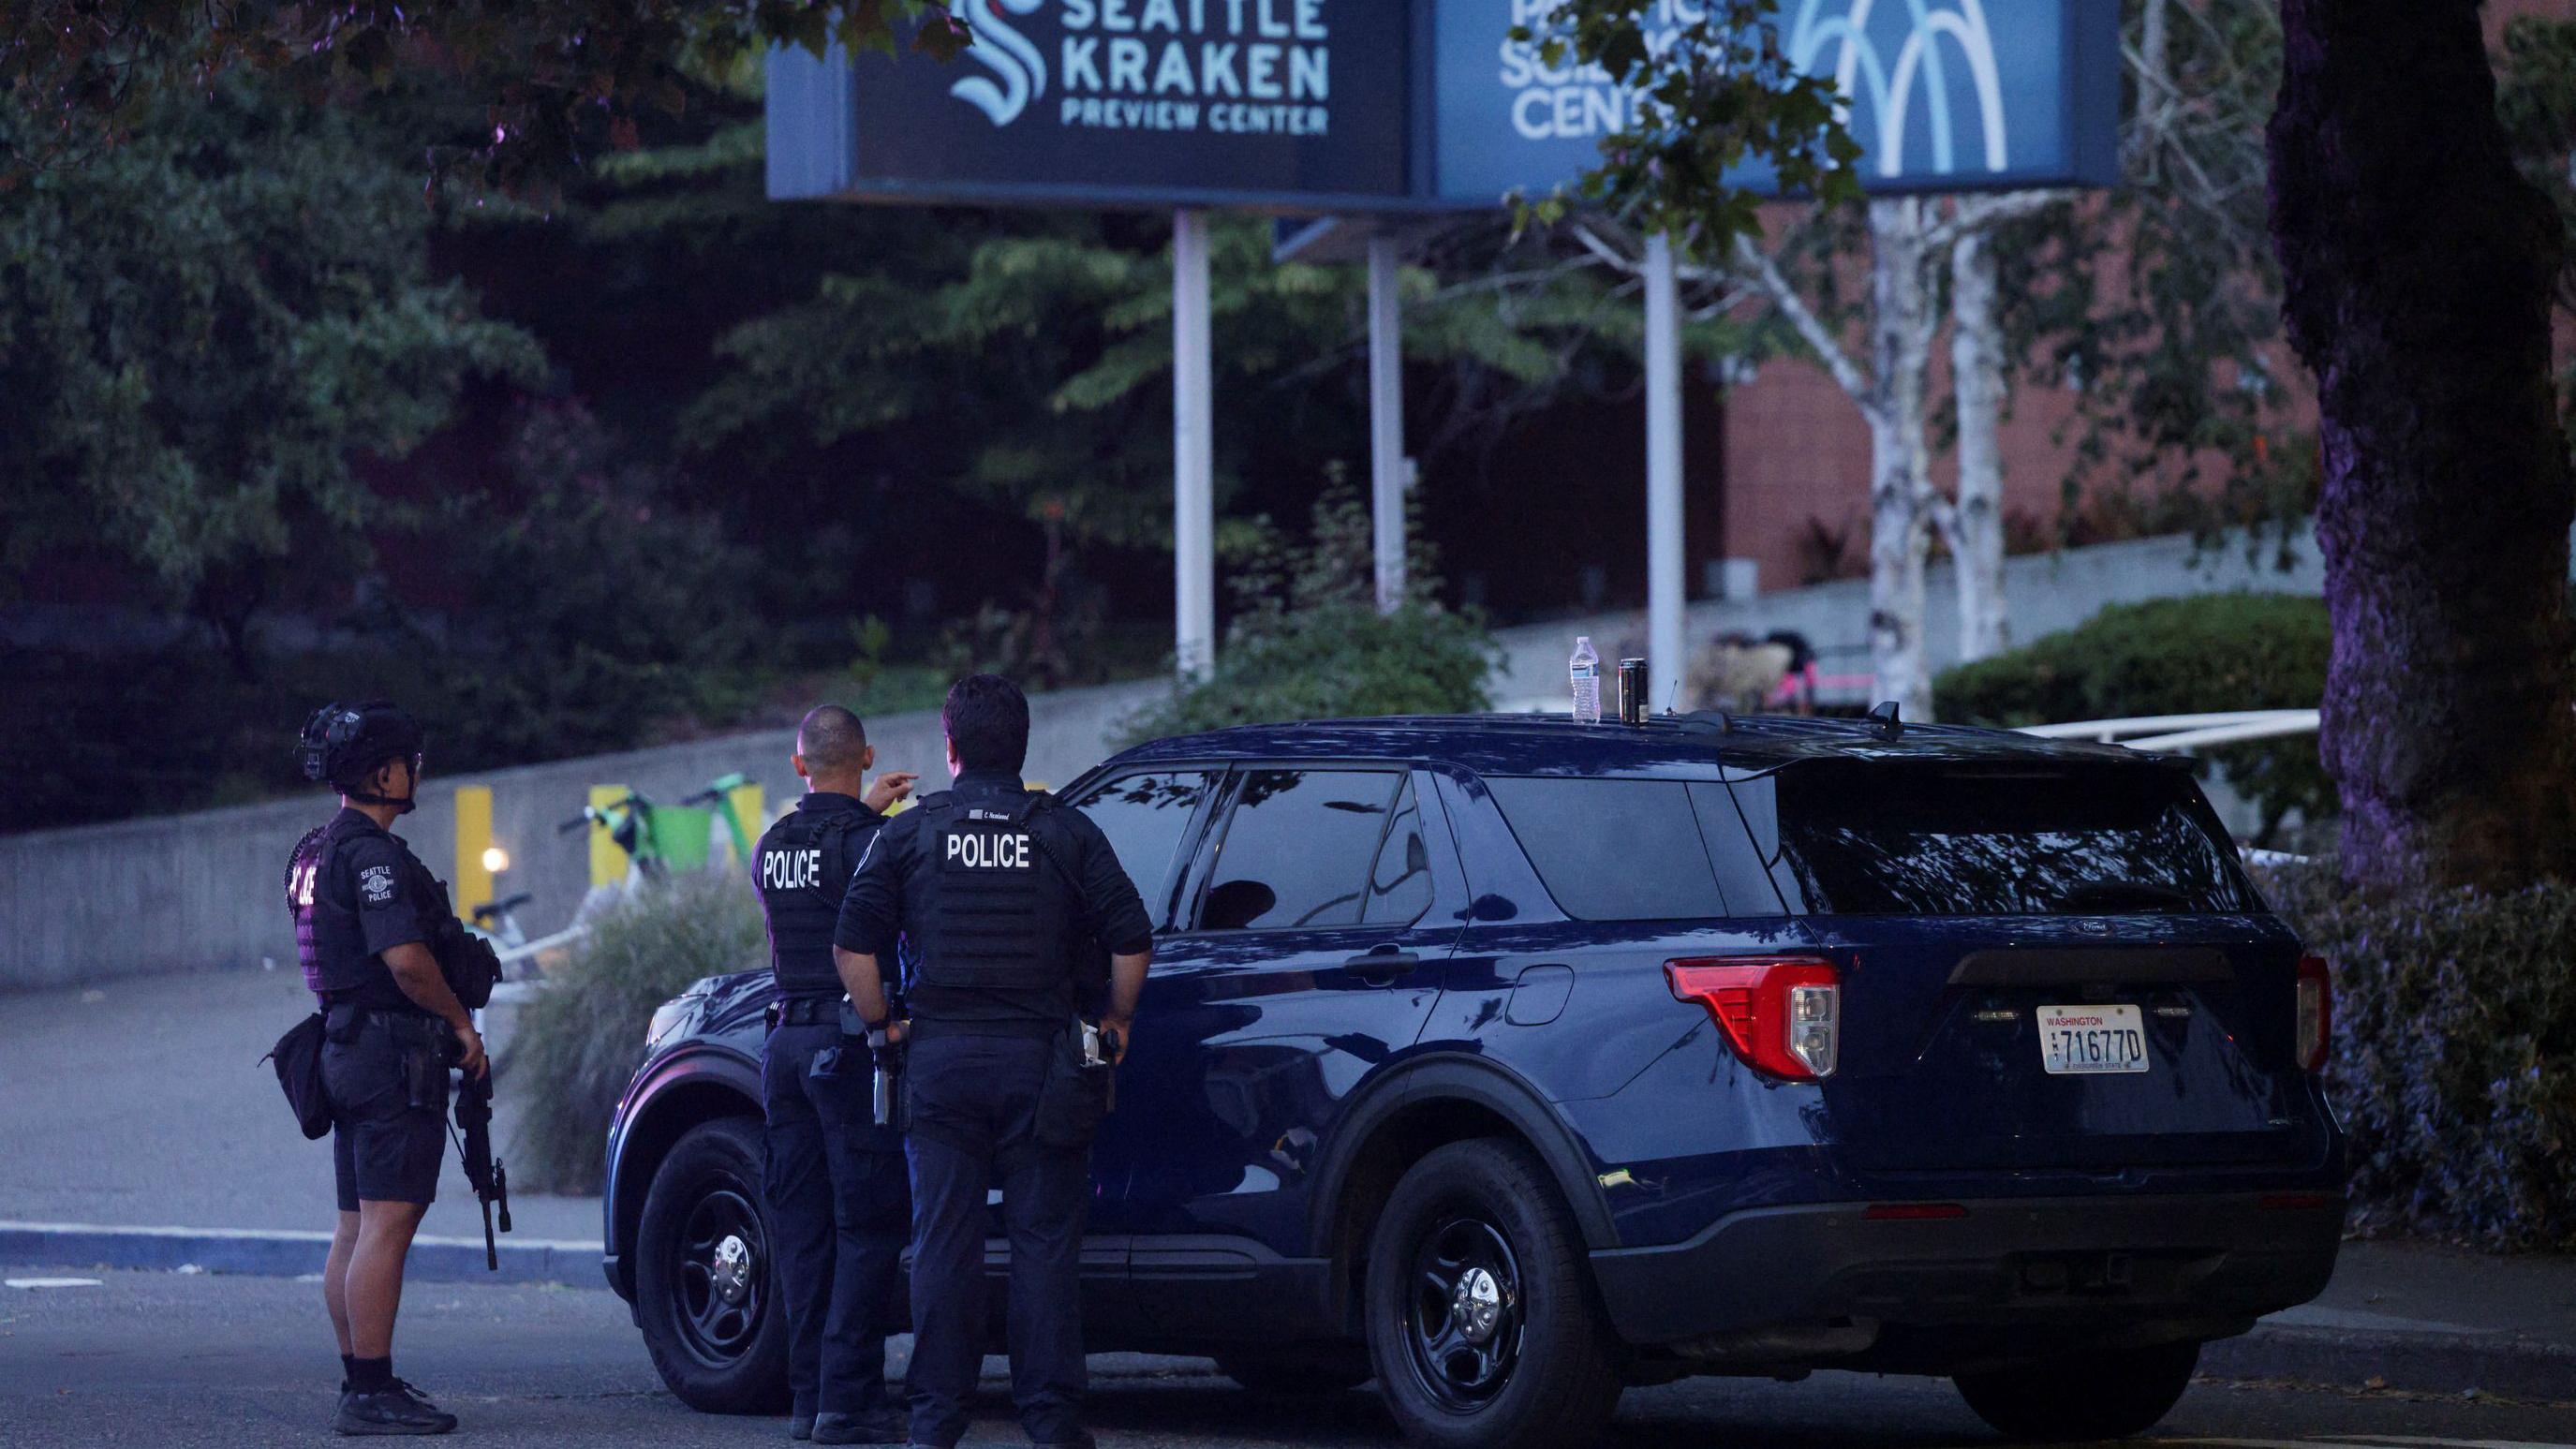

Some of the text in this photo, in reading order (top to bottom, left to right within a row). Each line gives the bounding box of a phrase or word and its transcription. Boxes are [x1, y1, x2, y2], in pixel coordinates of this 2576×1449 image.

[1061, 36, 1329, 101] KRAKEN
[1060, 96, 1329, 136] PREVIEW CENTER
[947, 833, 1029, 868] POLICE
[361, 865, 392, 880] SEATTLE
[763, 849, 821, 890] POLICE
[368, 890, 392, 903] POLICE
[2047, 1016, 2104, 1027] WASHINGTON
[2060, 1029, 2141, 1062] 71677D
